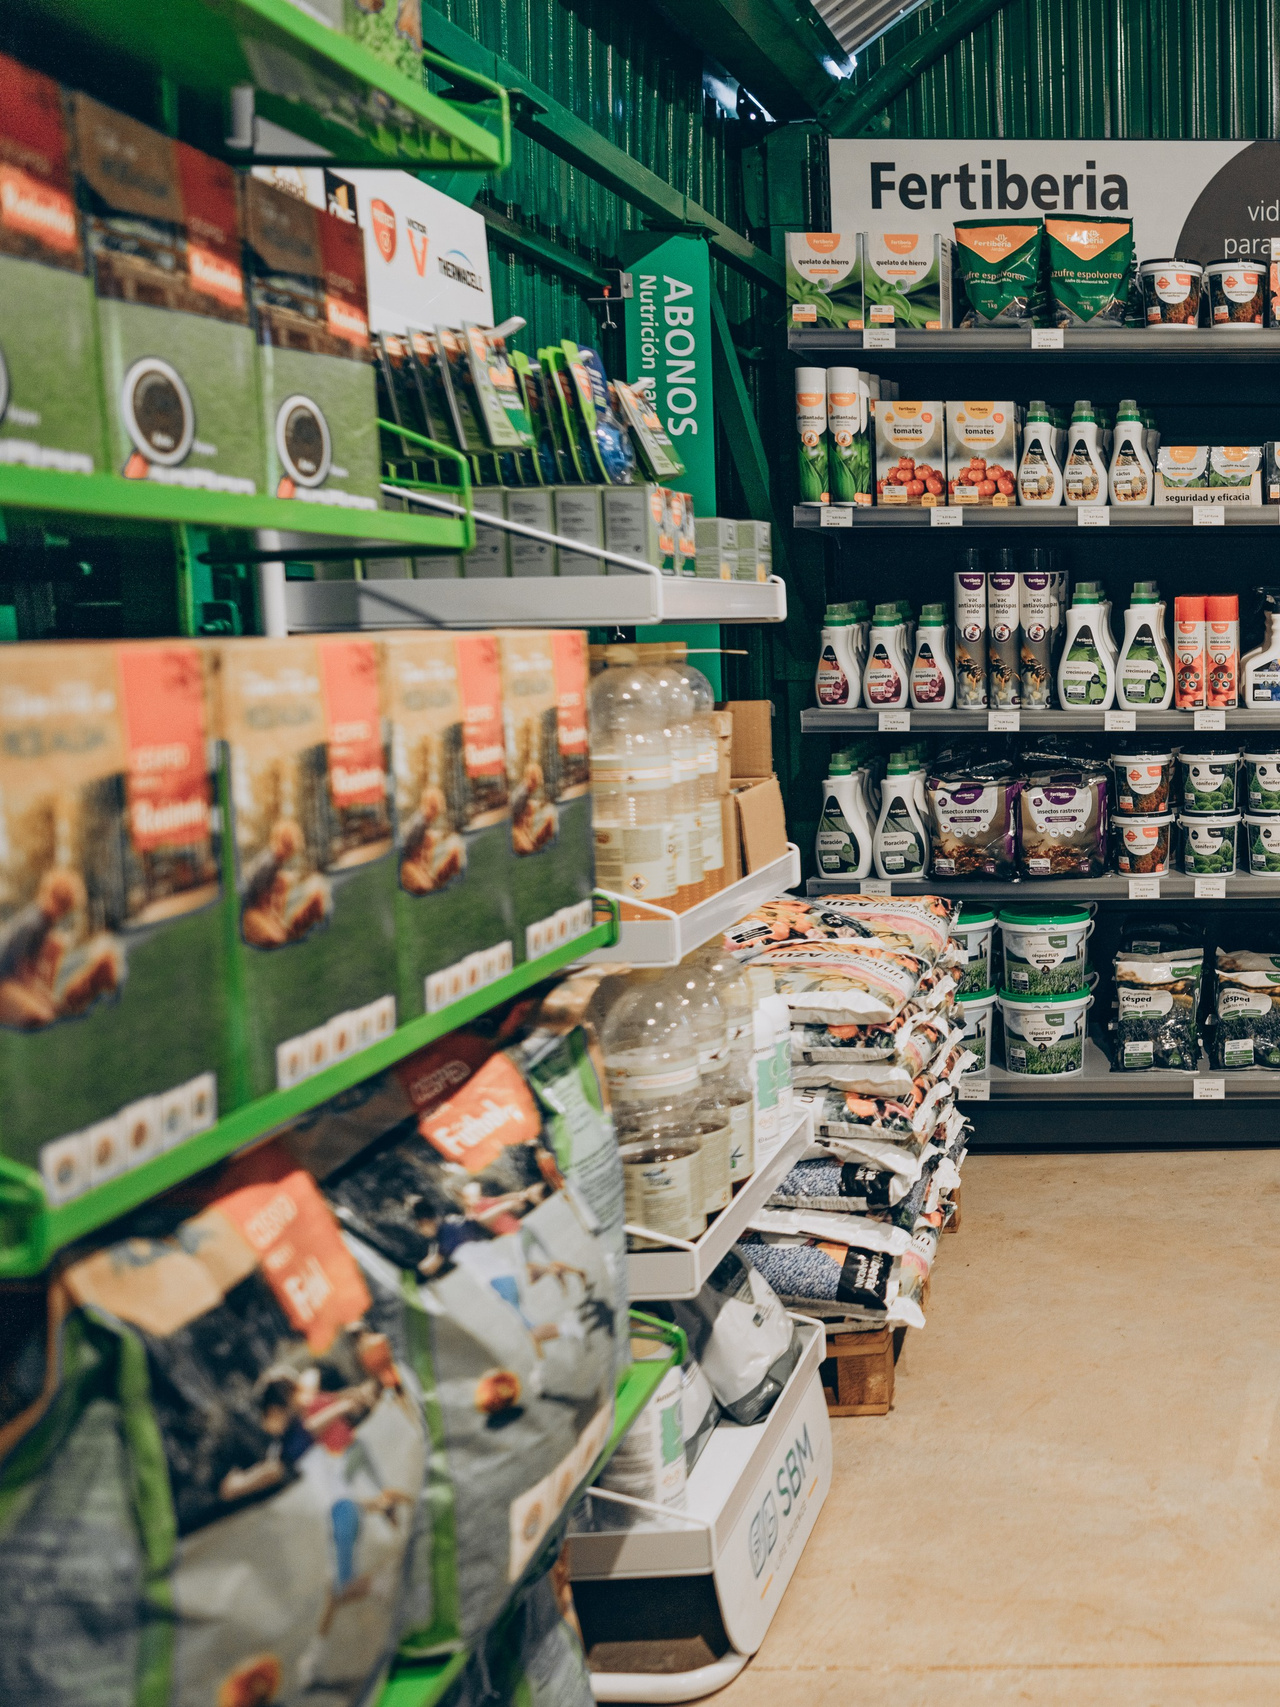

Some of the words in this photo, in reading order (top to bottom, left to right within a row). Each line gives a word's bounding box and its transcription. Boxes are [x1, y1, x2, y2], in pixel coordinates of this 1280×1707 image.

[870, 158, 1129, 211] Fertiberia
[406, 216, 427, 235] VICTOR
[437, 256, 484, 293] THERMACELL
[982, 270, 1025, 281] espolvoreo
[1077, 271, 1122, 279] espolvoreo
[639, 274, 660, 370] Nutrición
[662, 274, 698, 436] ABONOS
[1166, 494, 1208, 504] seguridad
[1210, 495, 1216, 503] y
[1218, 494, 1250, 502] eficacia
[1122, 994, 1152, 1005] césped
[1222, 995, 1250, 1005] césped
[776, 1421, 814, 1517] SBM
